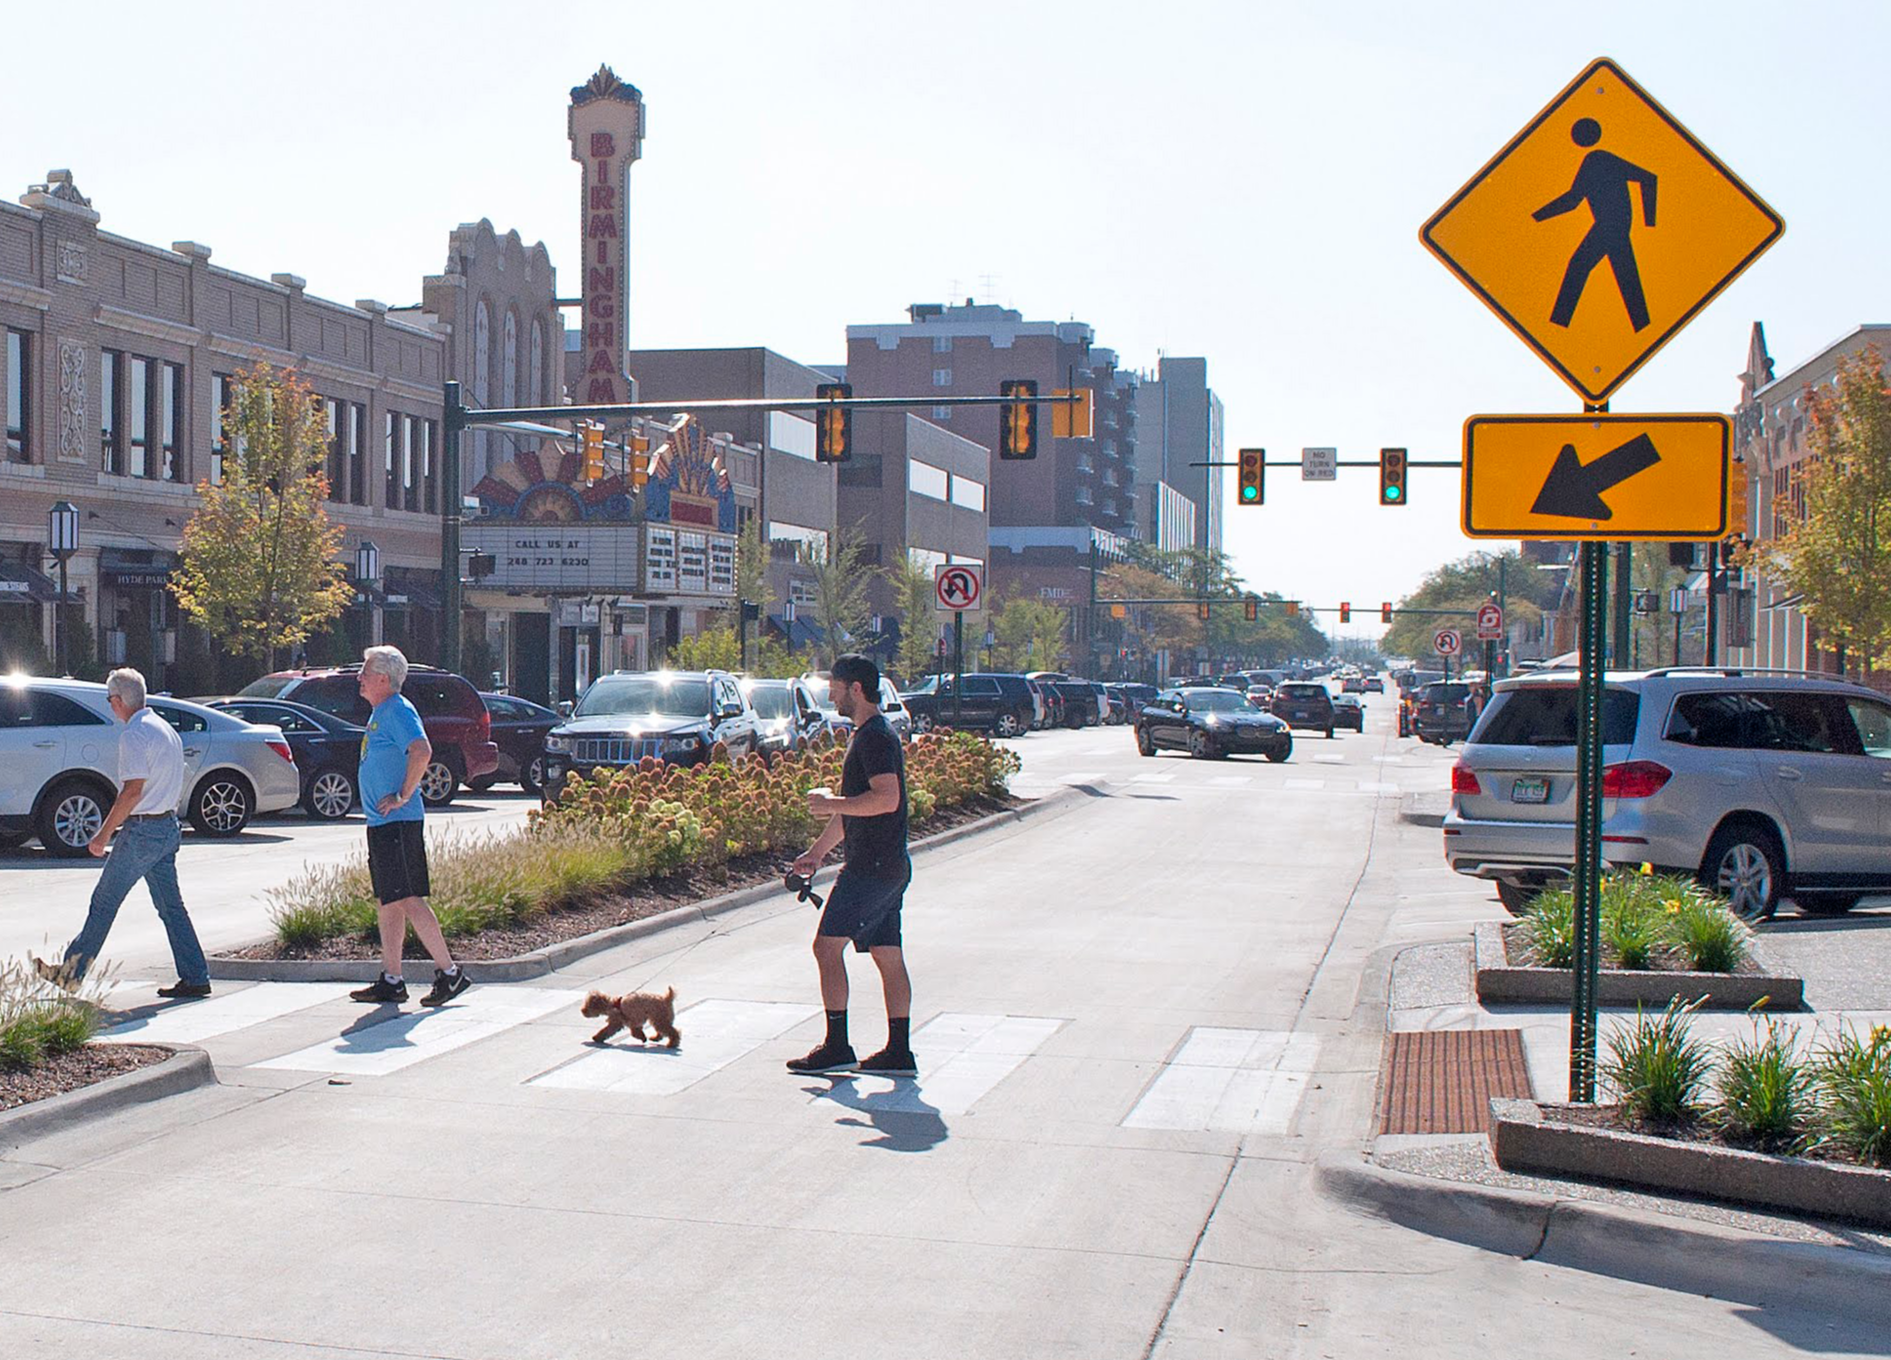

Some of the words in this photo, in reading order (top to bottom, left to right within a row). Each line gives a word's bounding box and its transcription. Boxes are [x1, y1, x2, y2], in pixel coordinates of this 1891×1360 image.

[587, 132, 618, 404] BIRMINGHAM
[1312, 451, 1326, 459] NO
[1309, 460, 1330, 468] TURN
[515, 540, 541, 549] CALL
[548, 540, 562, 549] US
[567, 540, 580, 549] AT
[507, 557, 528, 567] 248
[535, 557, 554, 566] 723
[561, 557, 589, 567] 6230
[117, 574, 144, 585] HYDE
[145, 575, 170, 585] PARK
